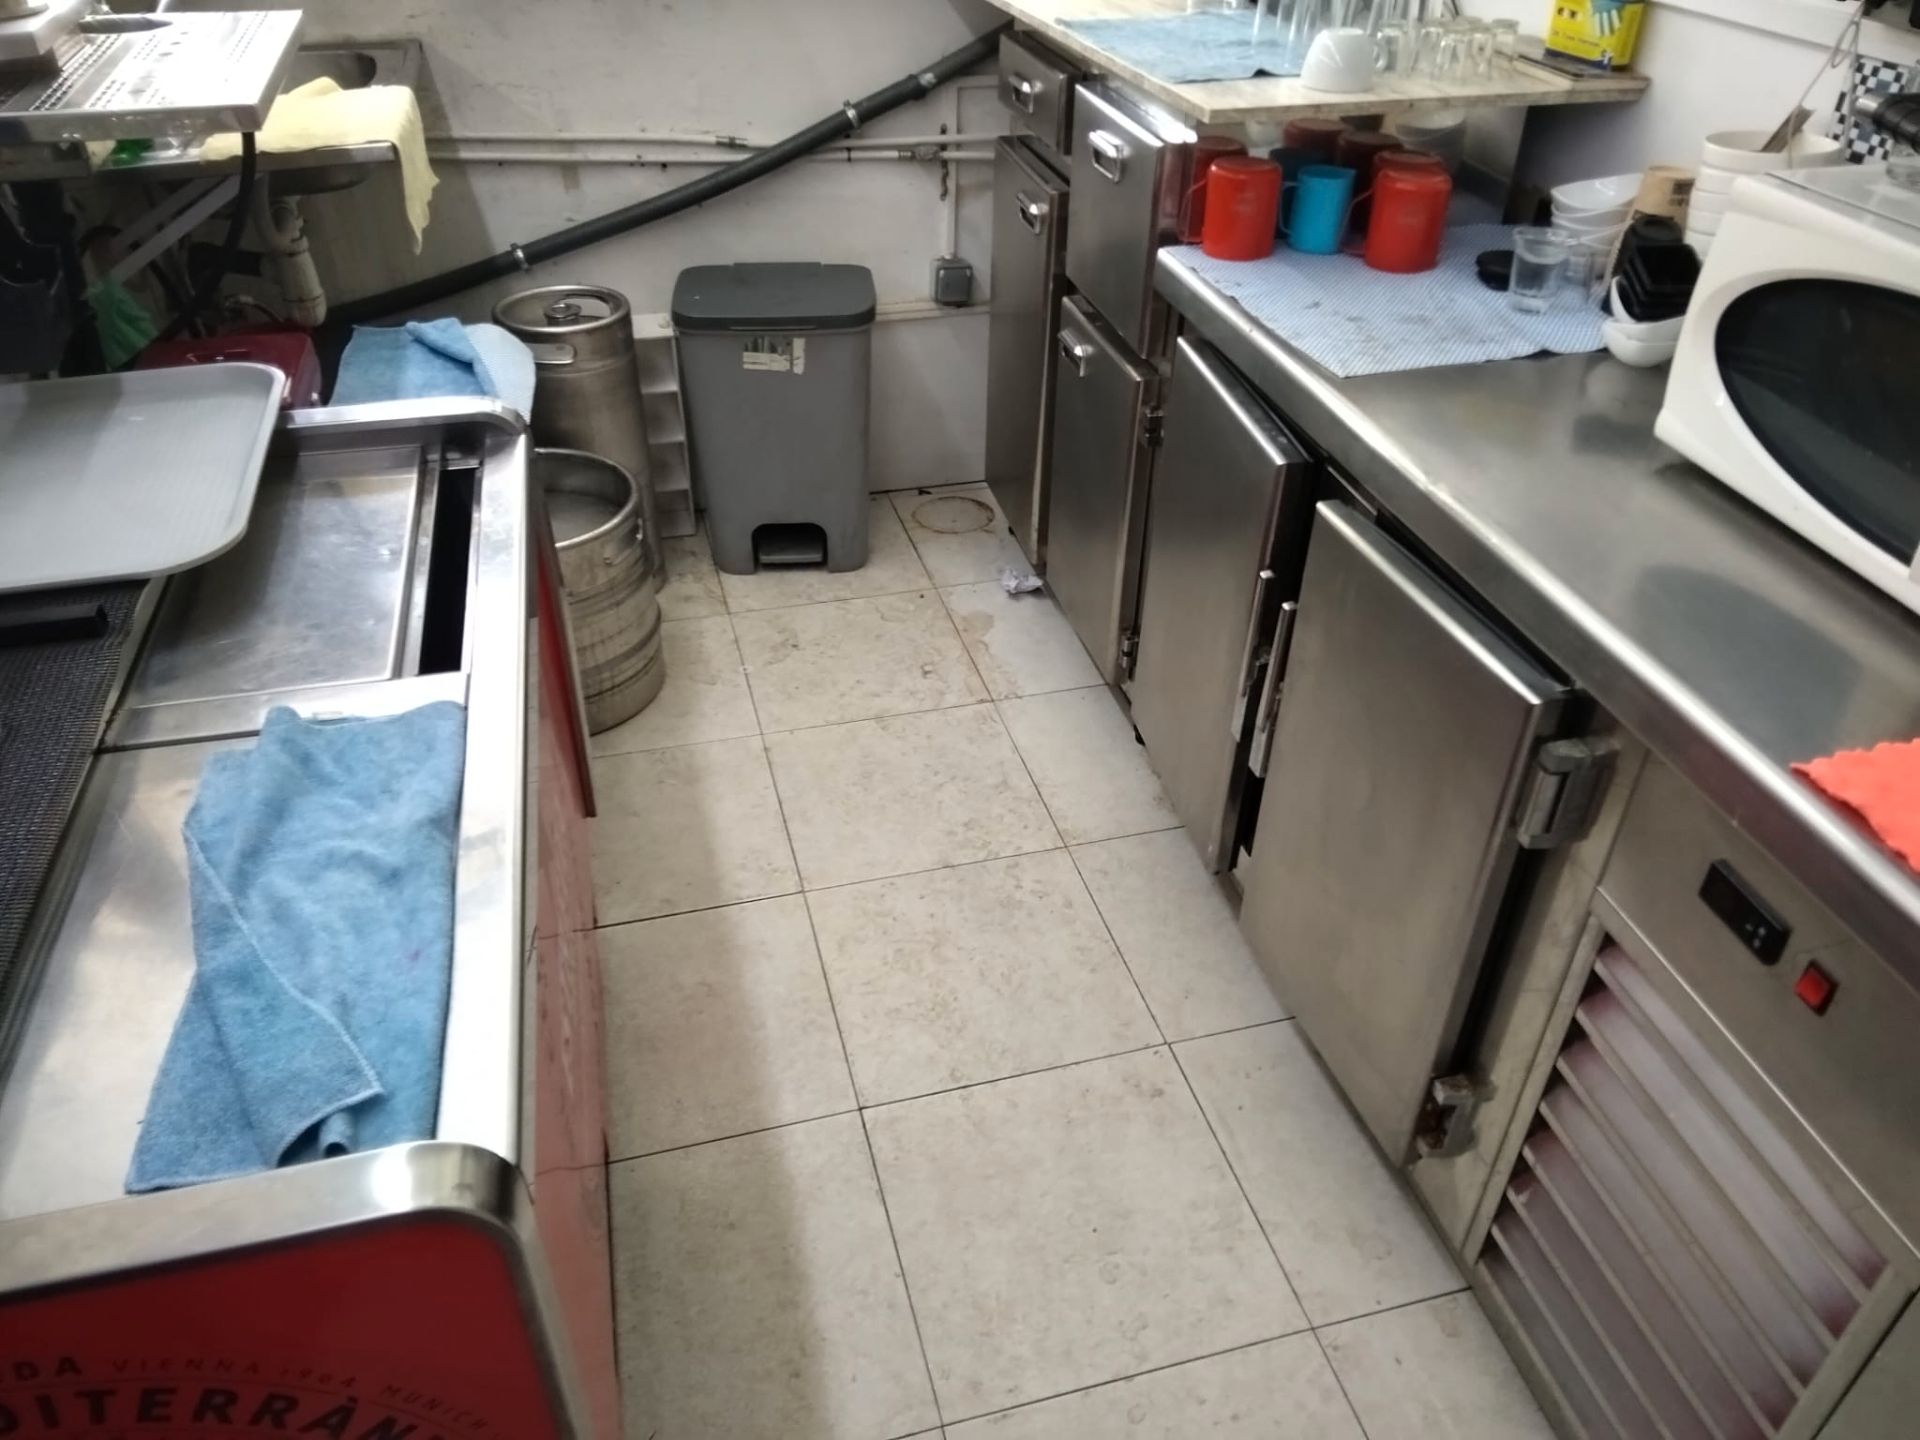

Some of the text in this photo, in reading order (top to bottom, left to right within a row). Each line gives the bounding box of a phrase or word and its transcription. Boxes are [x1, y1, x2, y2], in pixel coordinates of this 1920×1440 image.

[0, 1356, 83, 1382] DA
[112, 1356, 260, 1375] VIENNA
[0, 1387, 446, 1440] ITERRÀN
